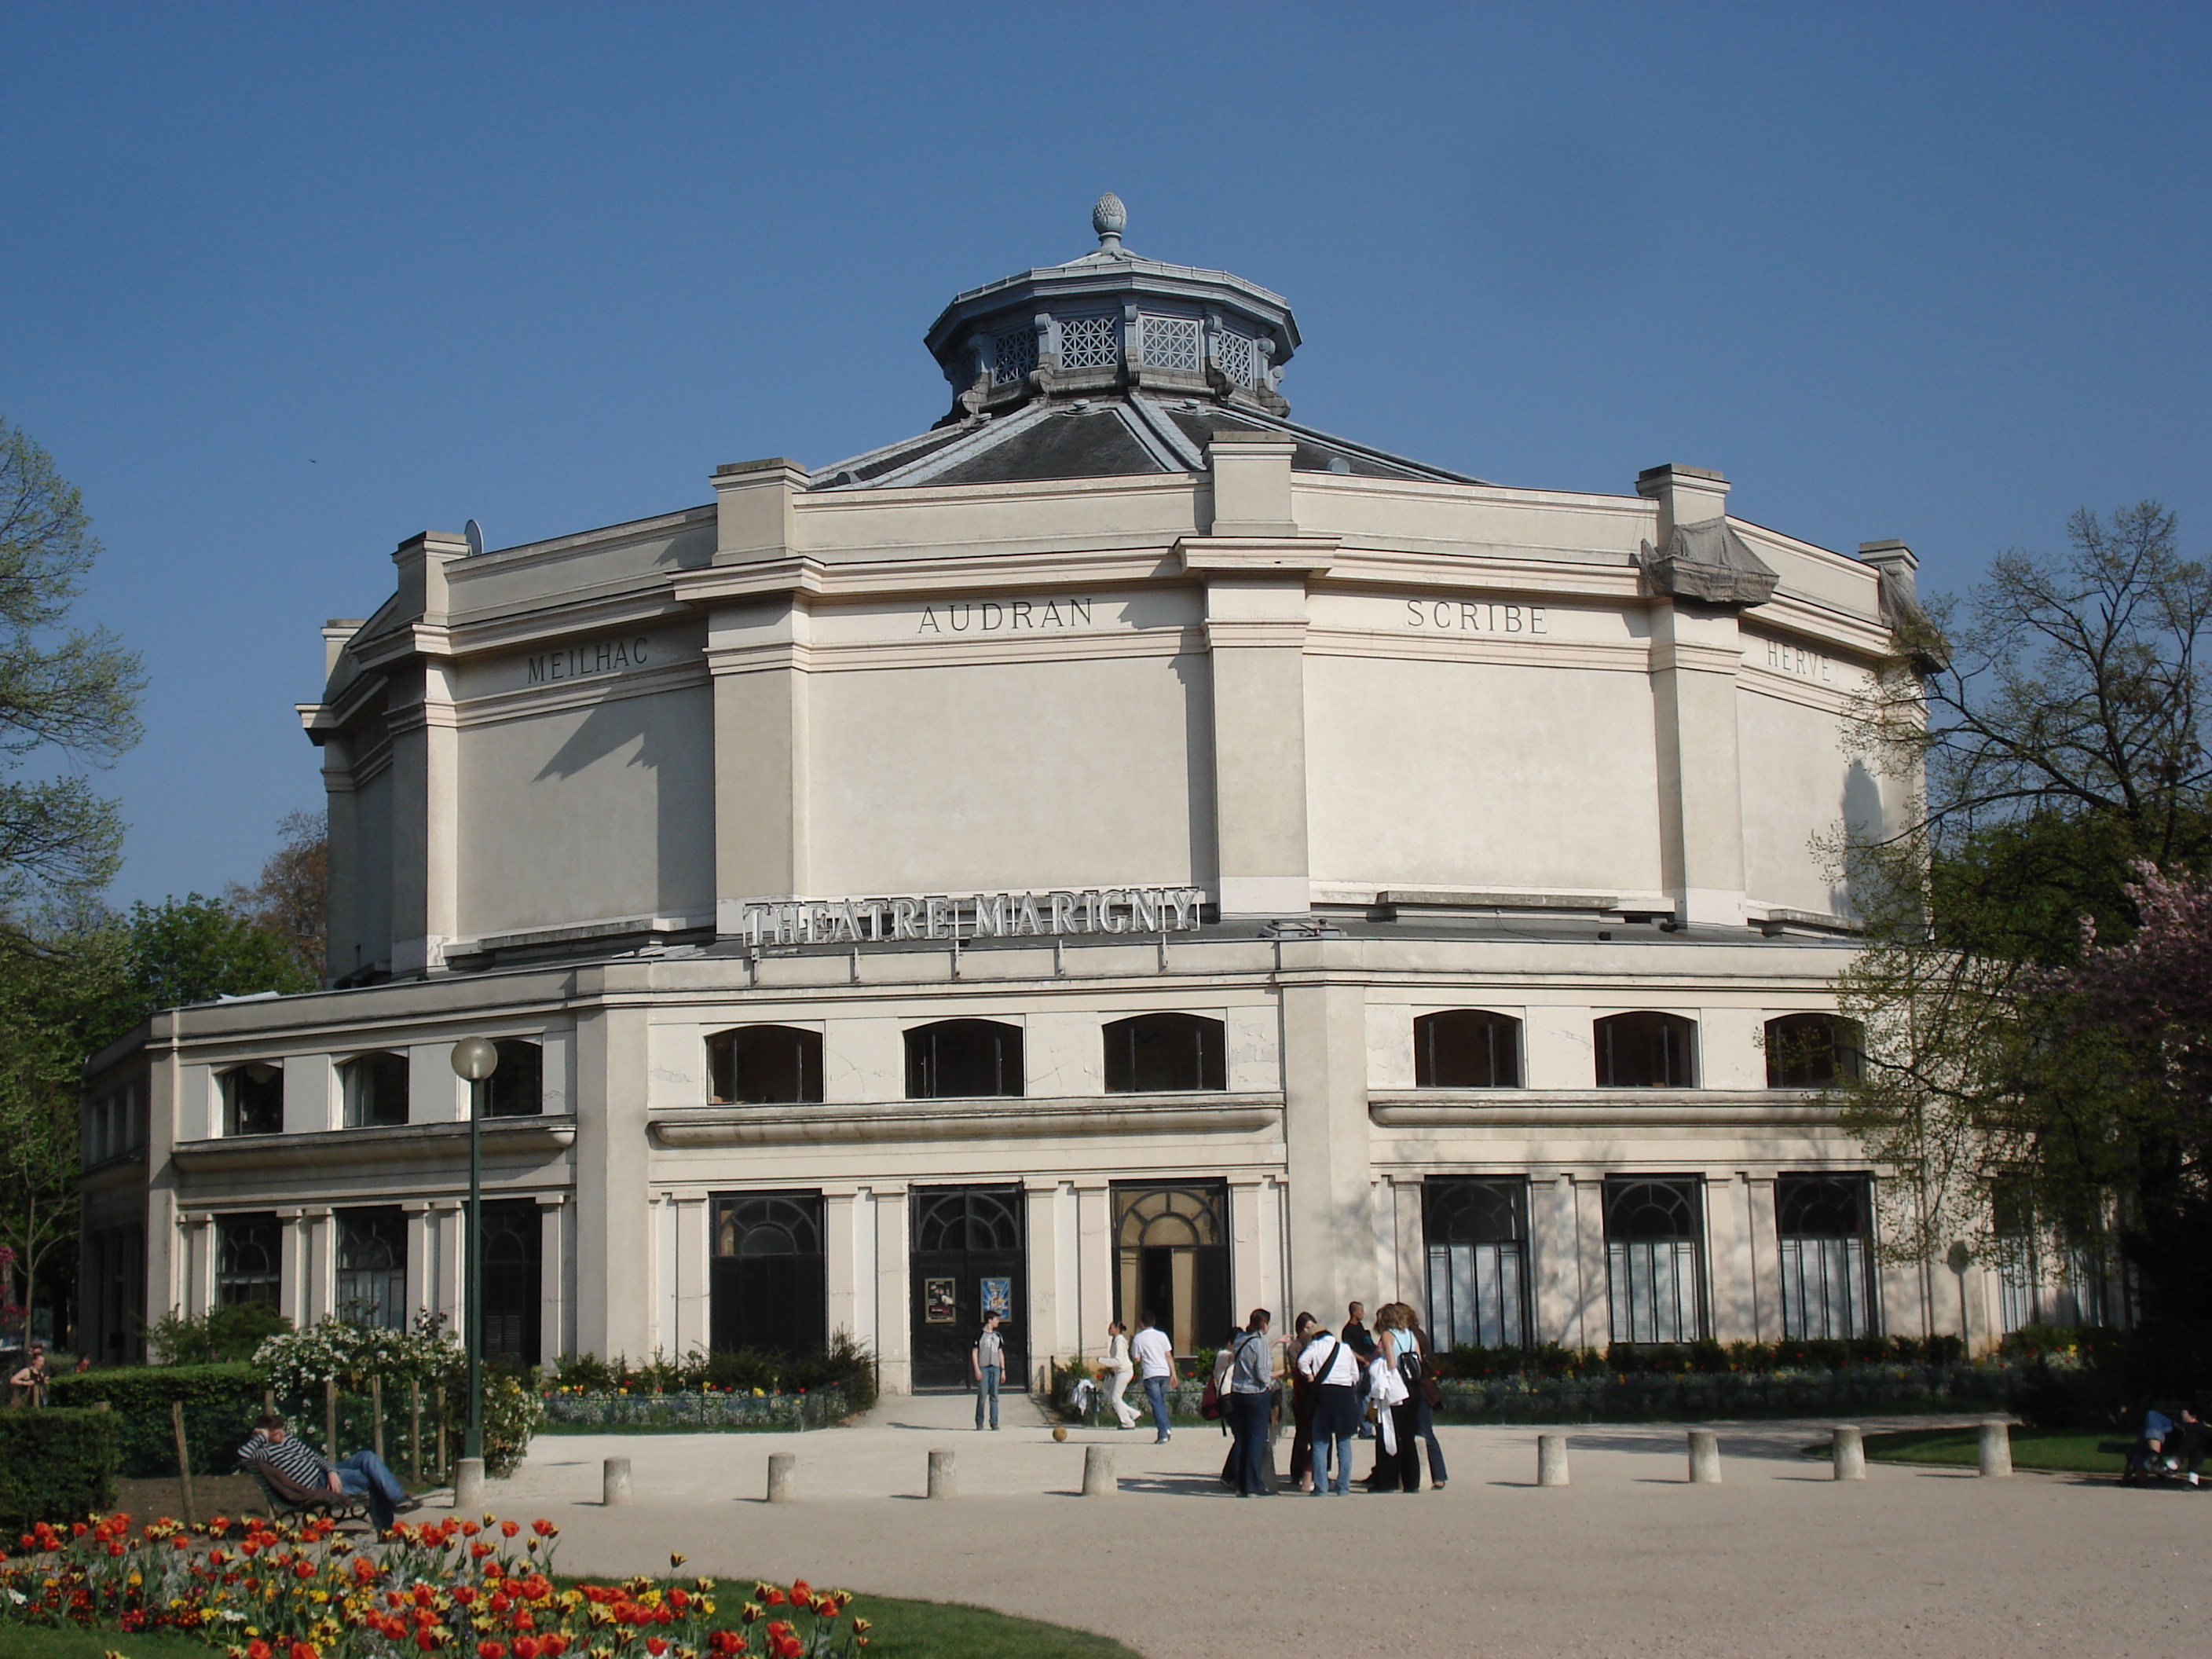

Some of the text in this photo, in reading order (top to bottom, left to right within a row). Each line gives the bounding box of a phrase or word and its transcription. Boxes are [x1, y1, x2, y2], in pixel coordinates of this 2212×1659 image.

[917, 598, 1093, 634] AUDRAN
[1407, 599, 1547, 635] SCRIBE
[528, 637, 647, 683] MEILHAC
[1767, 639, 1831, 682] HERVE
[743, 886, 1200, 947] THEATRE MARIGNY
